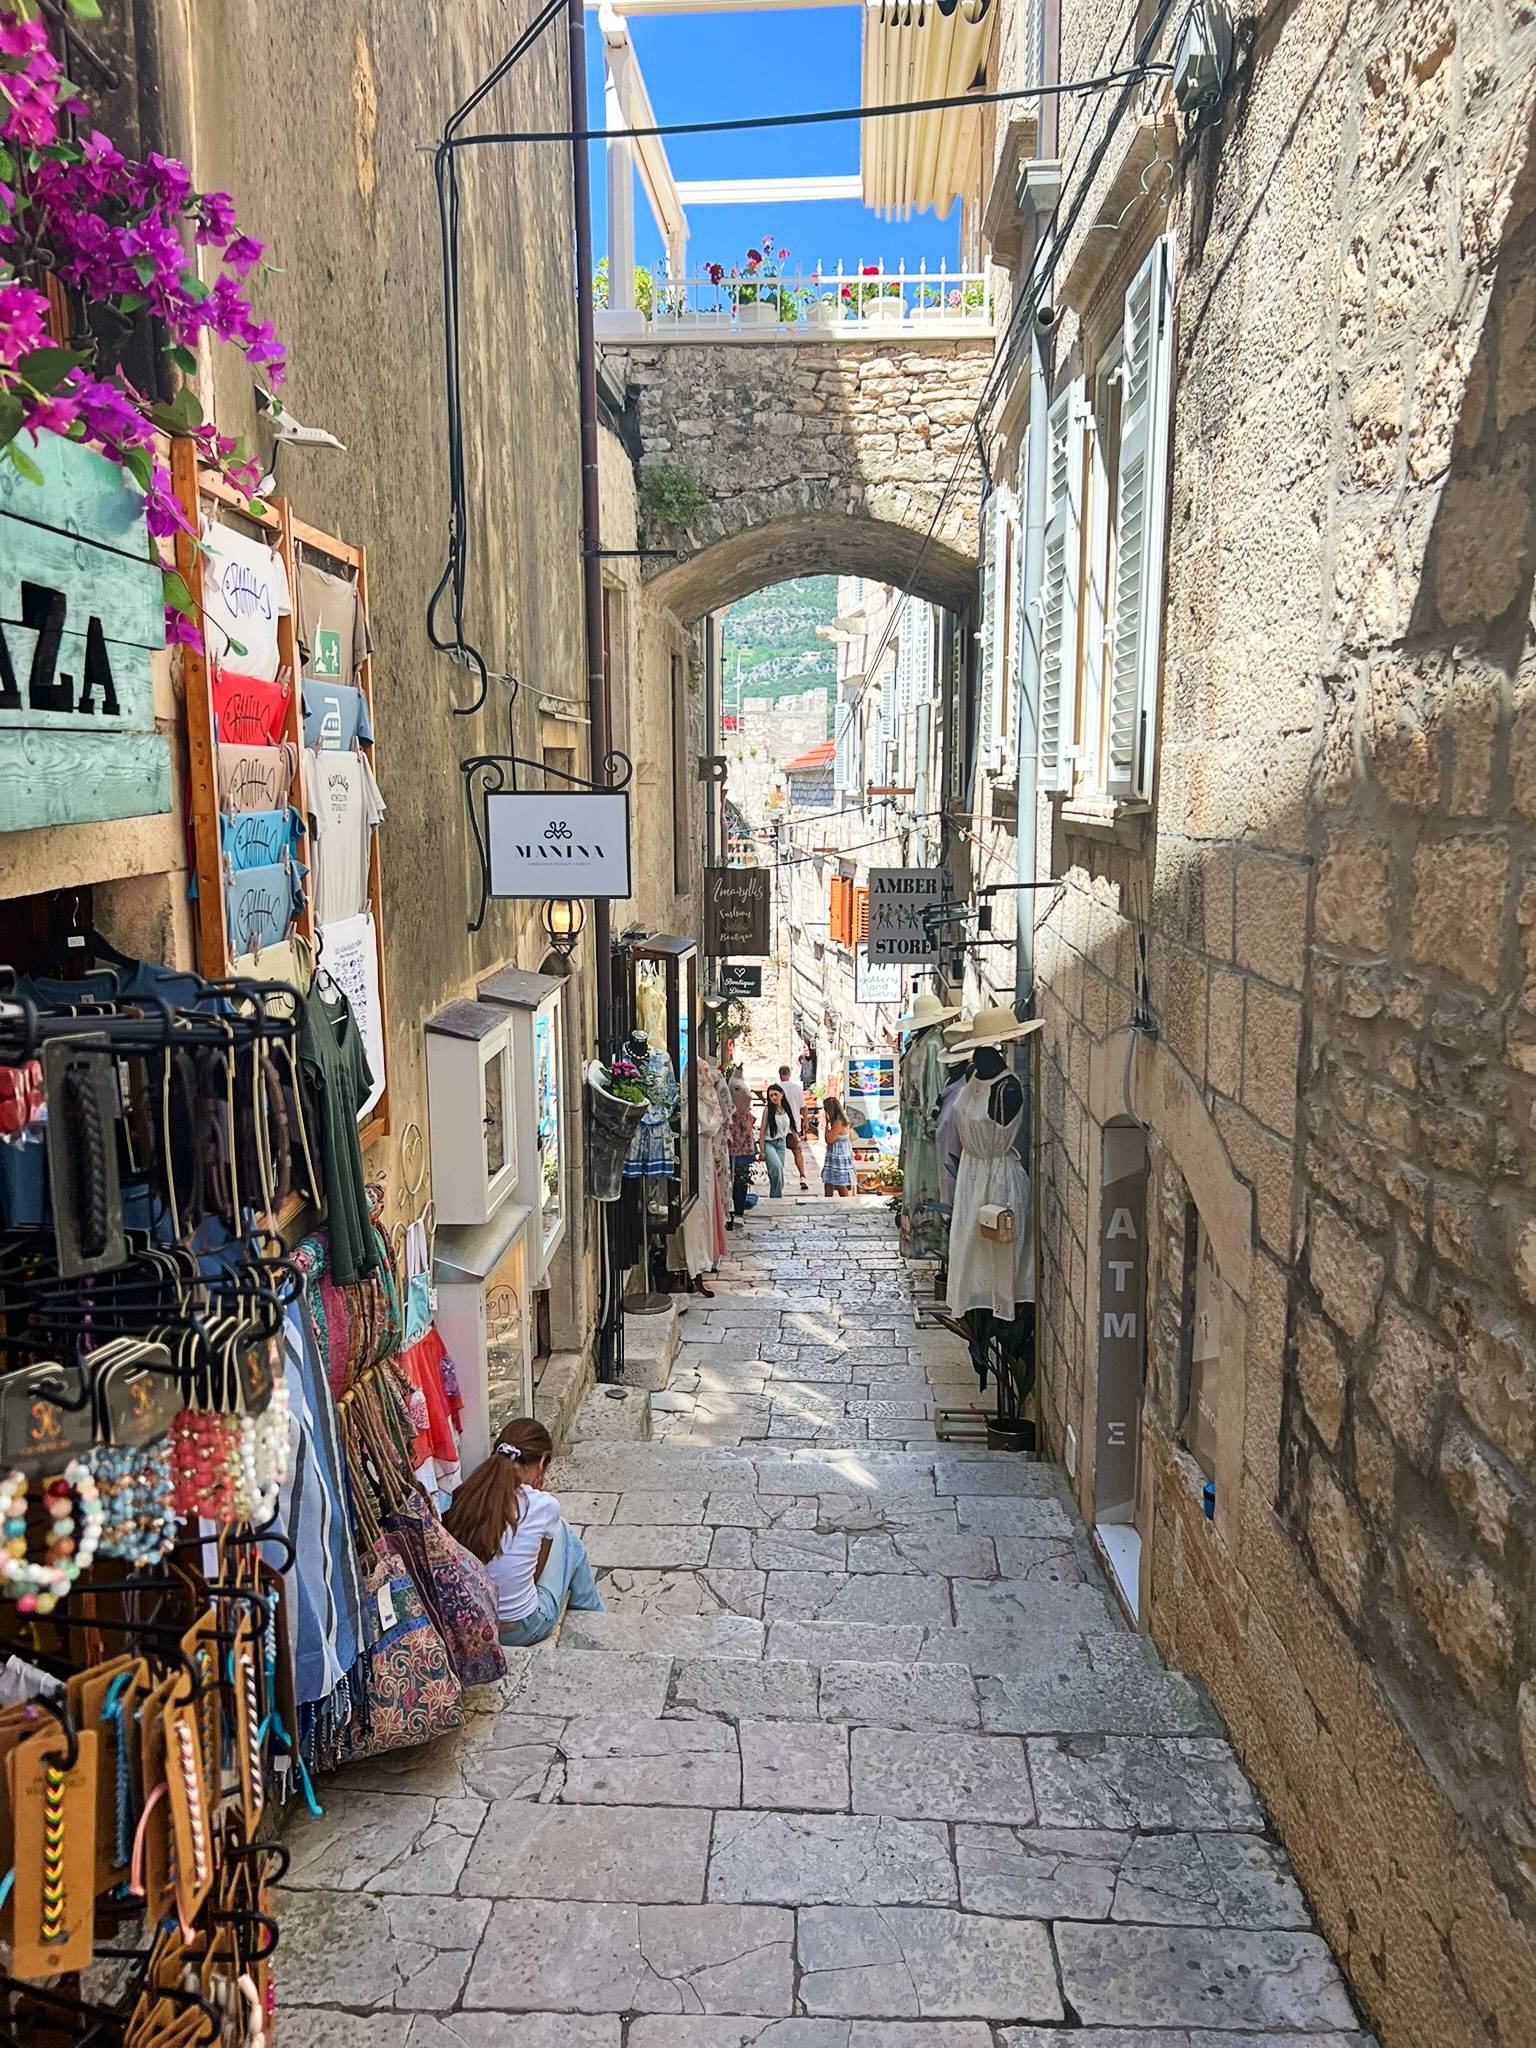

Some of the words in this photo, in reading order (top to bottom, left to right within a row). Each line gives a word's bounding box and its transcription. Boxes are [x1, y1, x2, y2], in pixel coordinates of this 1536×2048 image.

[515, 845, 605, 858] MANINA
[874, 878, 937, 894] AMBER
[875, 938, 932, 955] STORE
[1103, 1207, 1138, 1339] ATM
